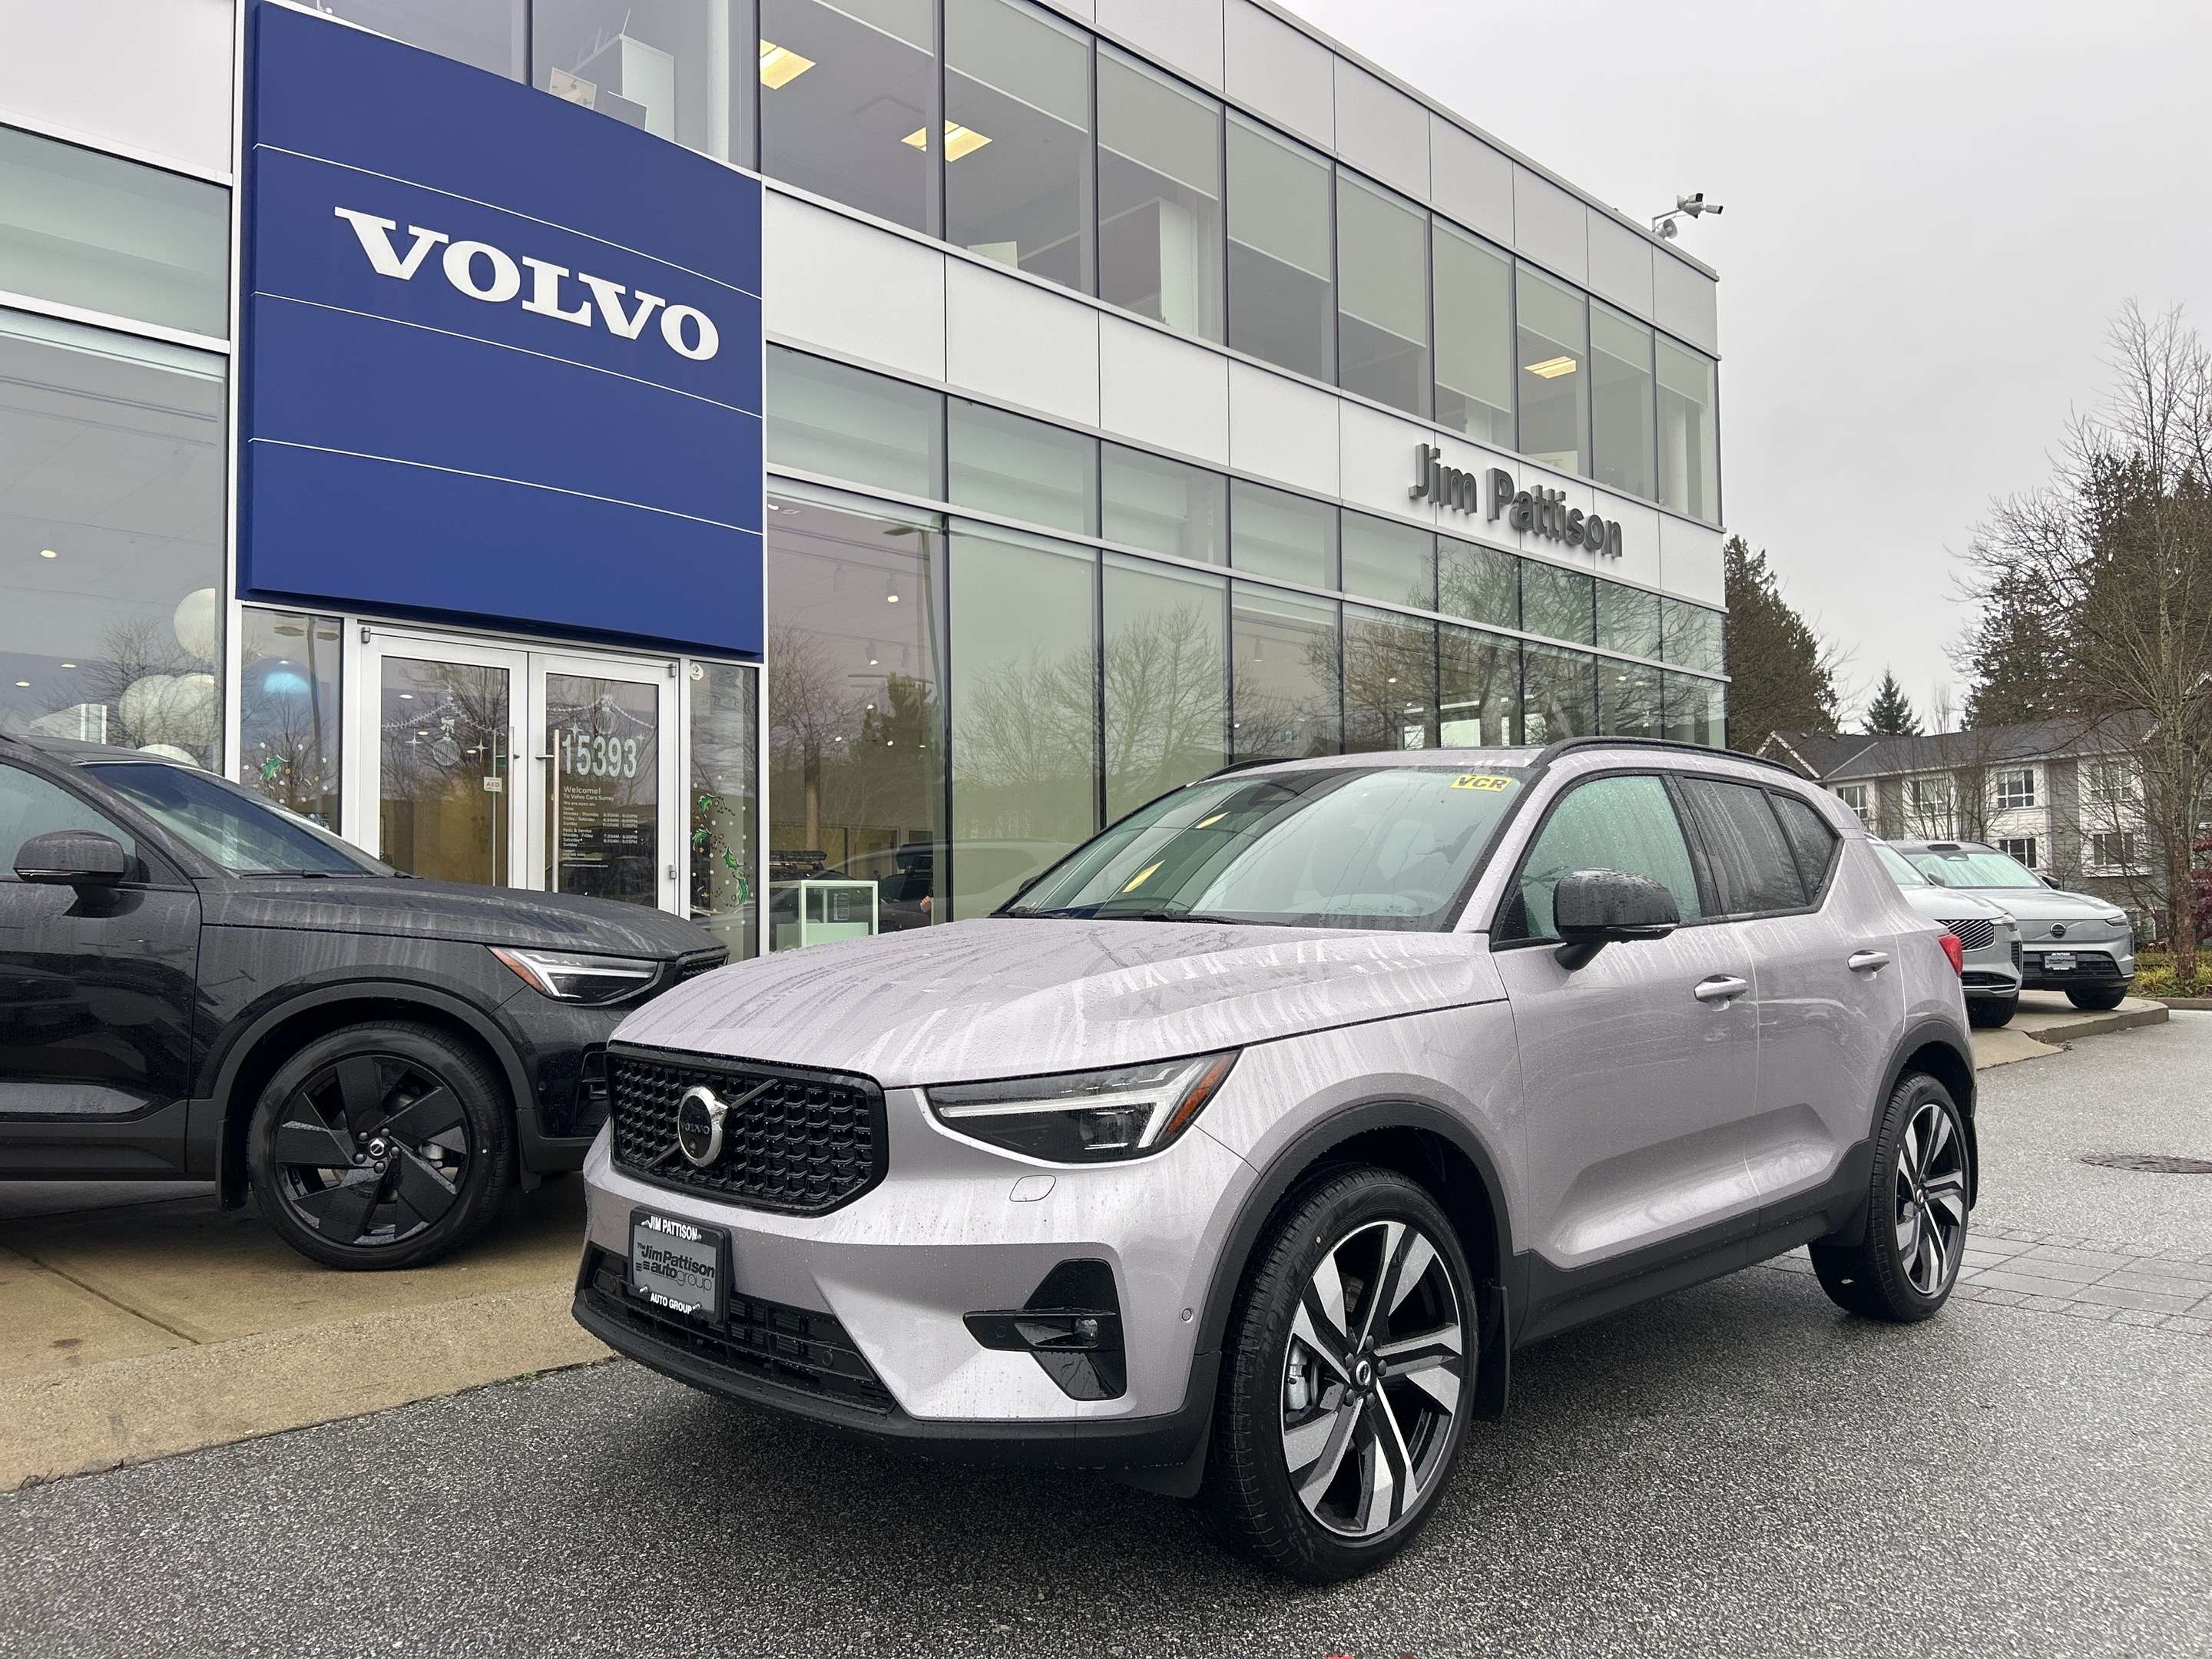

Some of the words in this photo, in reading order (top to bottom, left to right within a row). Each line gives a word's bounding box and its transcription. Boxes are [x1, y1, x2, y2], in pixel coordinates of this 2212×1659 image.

[334, 206, 719, 361] VOLVO
[1408, 443, 1478, 515] Jim
[1486, 467, 1623, 558] Pattison
[562, 733, 637, 779] 15393
[563, 786, 601, 795] Welcome!
[1458, 776, 1508, 790] VCR
[648, 1215, 661, 1232] JIM
[662, 1218, 698, 1241] PATTISON
[637, 1242, 646, 1250] The
[650, 1292, 668, 1307] AUTO
[668, 1299, 693, 1315] GROUP
